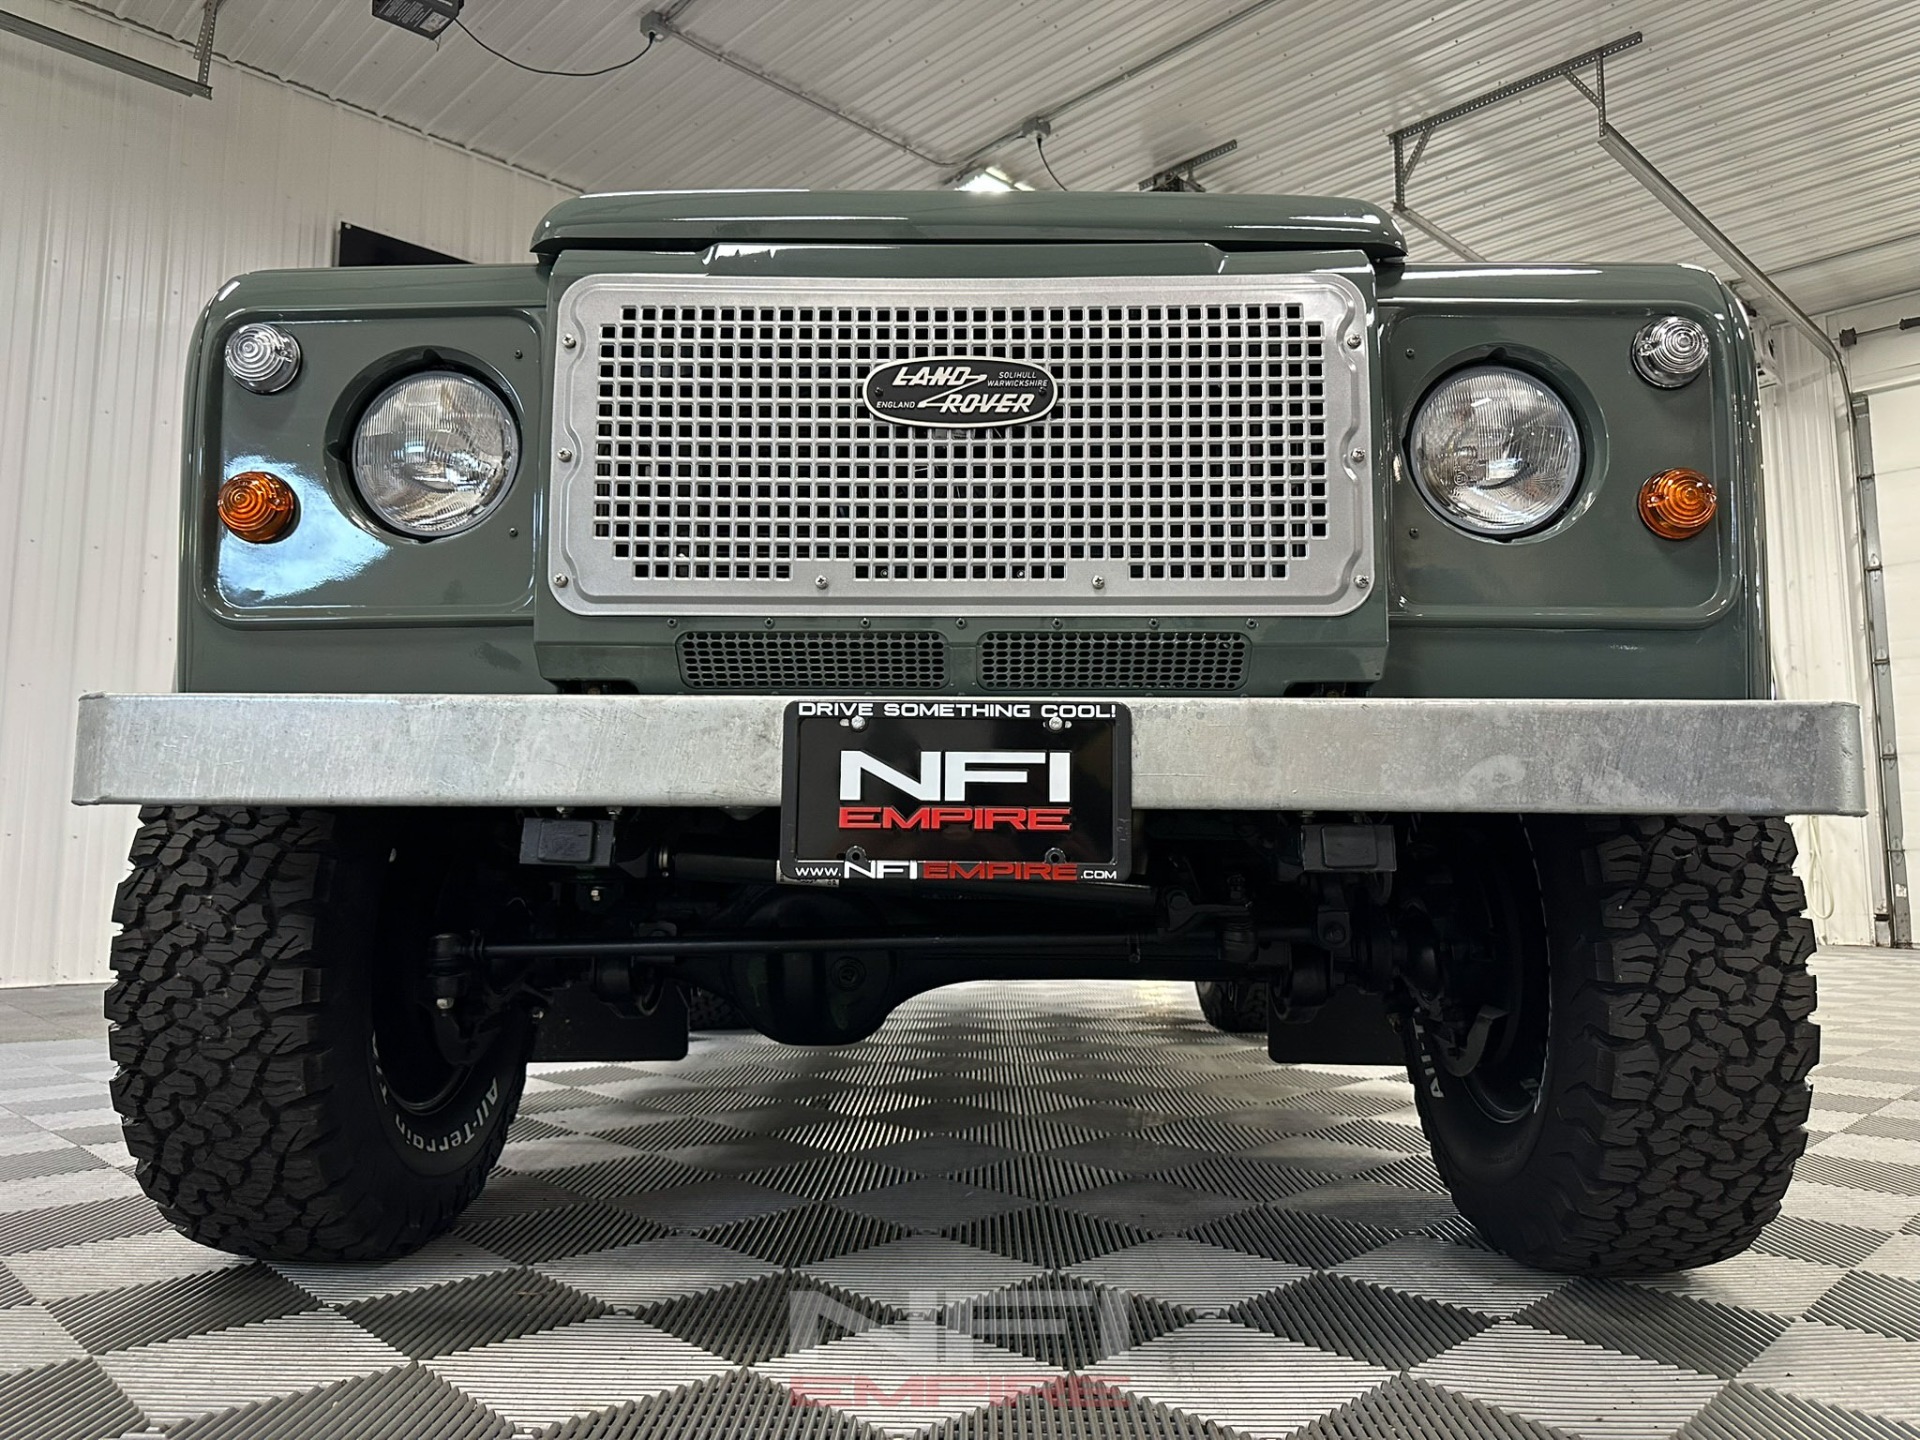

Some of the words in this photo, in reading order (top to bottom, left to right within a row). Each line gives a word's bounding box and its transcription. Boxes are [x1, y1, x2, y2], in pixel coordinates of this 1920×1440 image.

[892, 366, 972, 386] LAND
[987, 379, 1048, 388] WARWICKSHIRE
[998, 371, 1037, 379] SOLIHULL
[876, 401, 915, 409] ENGLAND
[939, 393, 1035, 413] ROVER
[798, 702, 874, 717] DRIVE
[883, 704, 1031, 718] SOMETHING
[1040, 704, 1117, 719] COOL!
[839, 750, 1072, 803] NFI
[838, 806, 1073, 831] EMPIRE
[395, 1076, 499, 1152] All-Terrain
